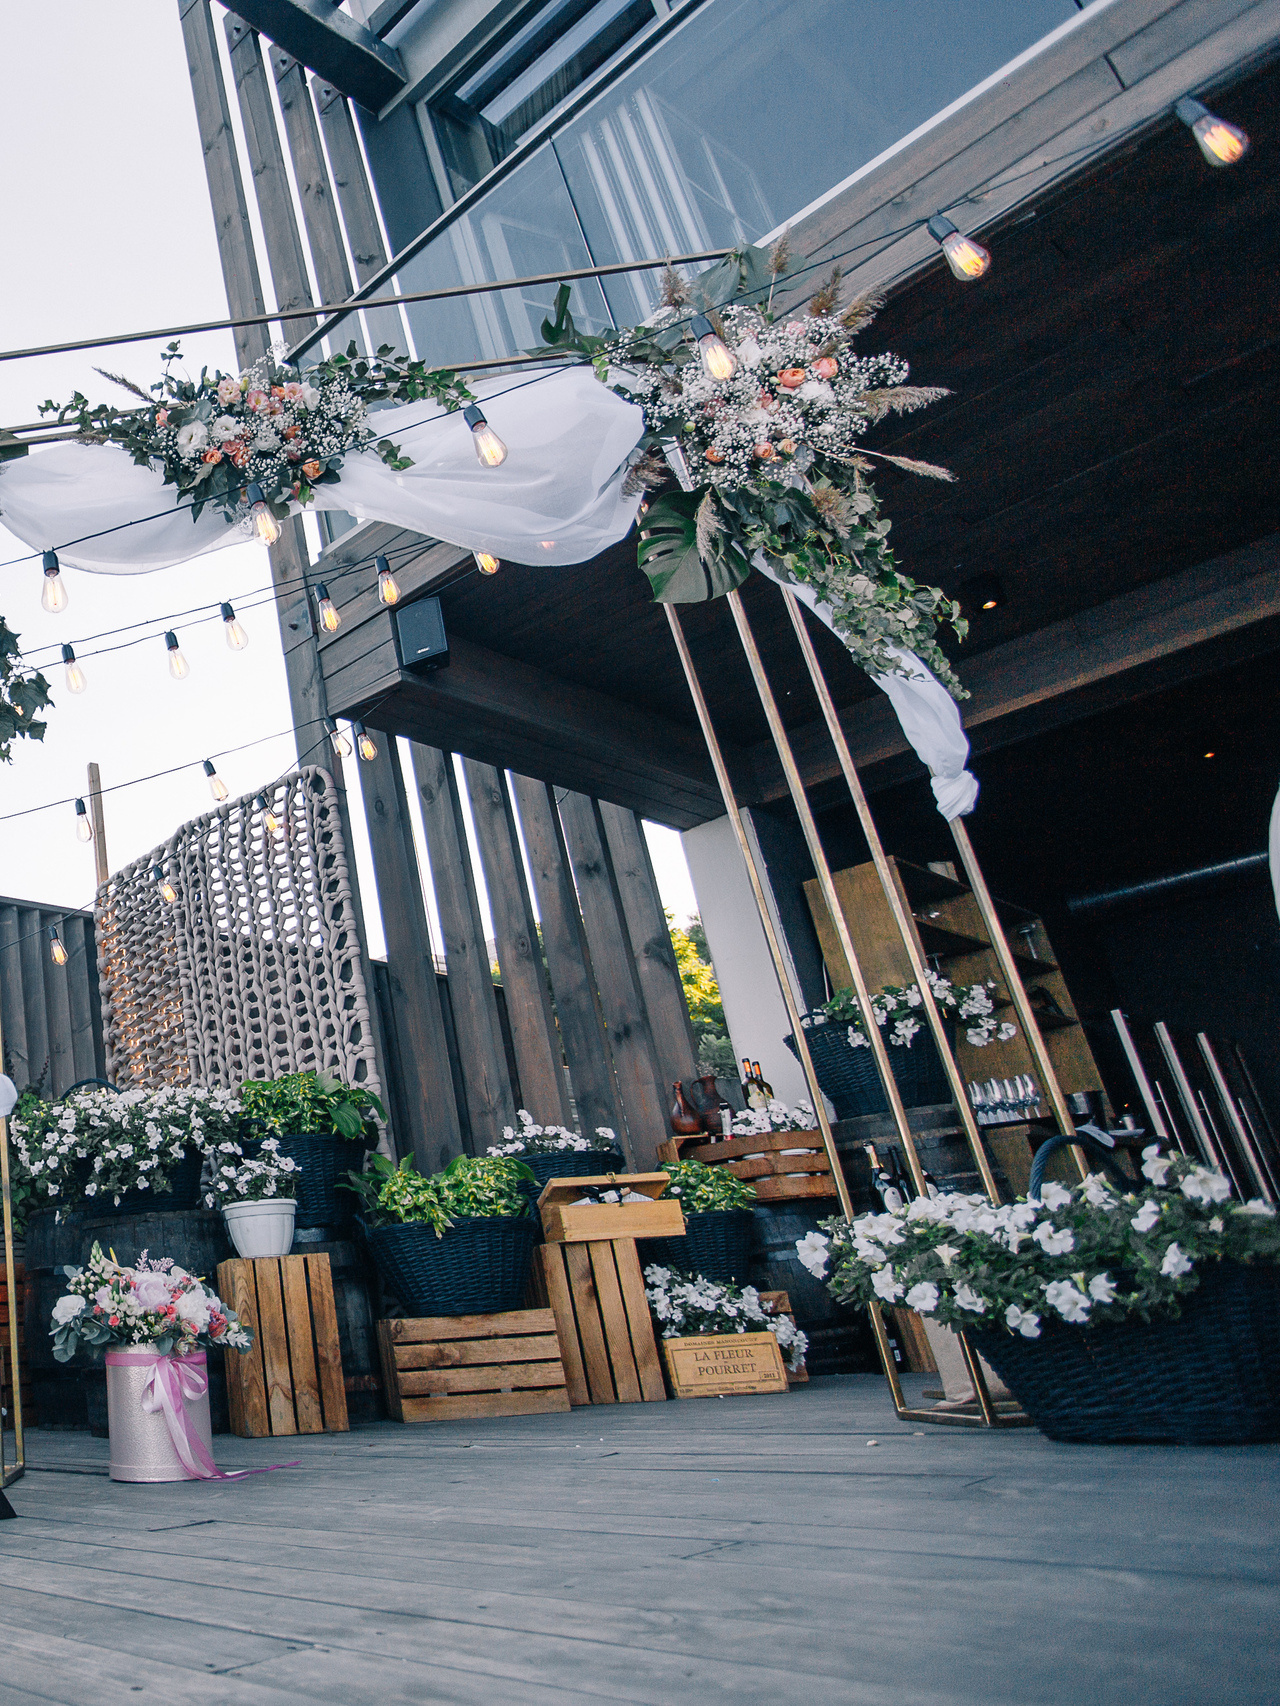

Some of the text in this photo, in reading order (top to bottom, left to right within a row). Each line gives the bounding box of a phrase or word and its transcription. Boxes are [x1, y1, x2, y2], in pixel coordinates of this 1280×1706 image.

[694, 1349, 754, 1361] LA FLEUR
[698, 1363, 756, 1376] POURRET
